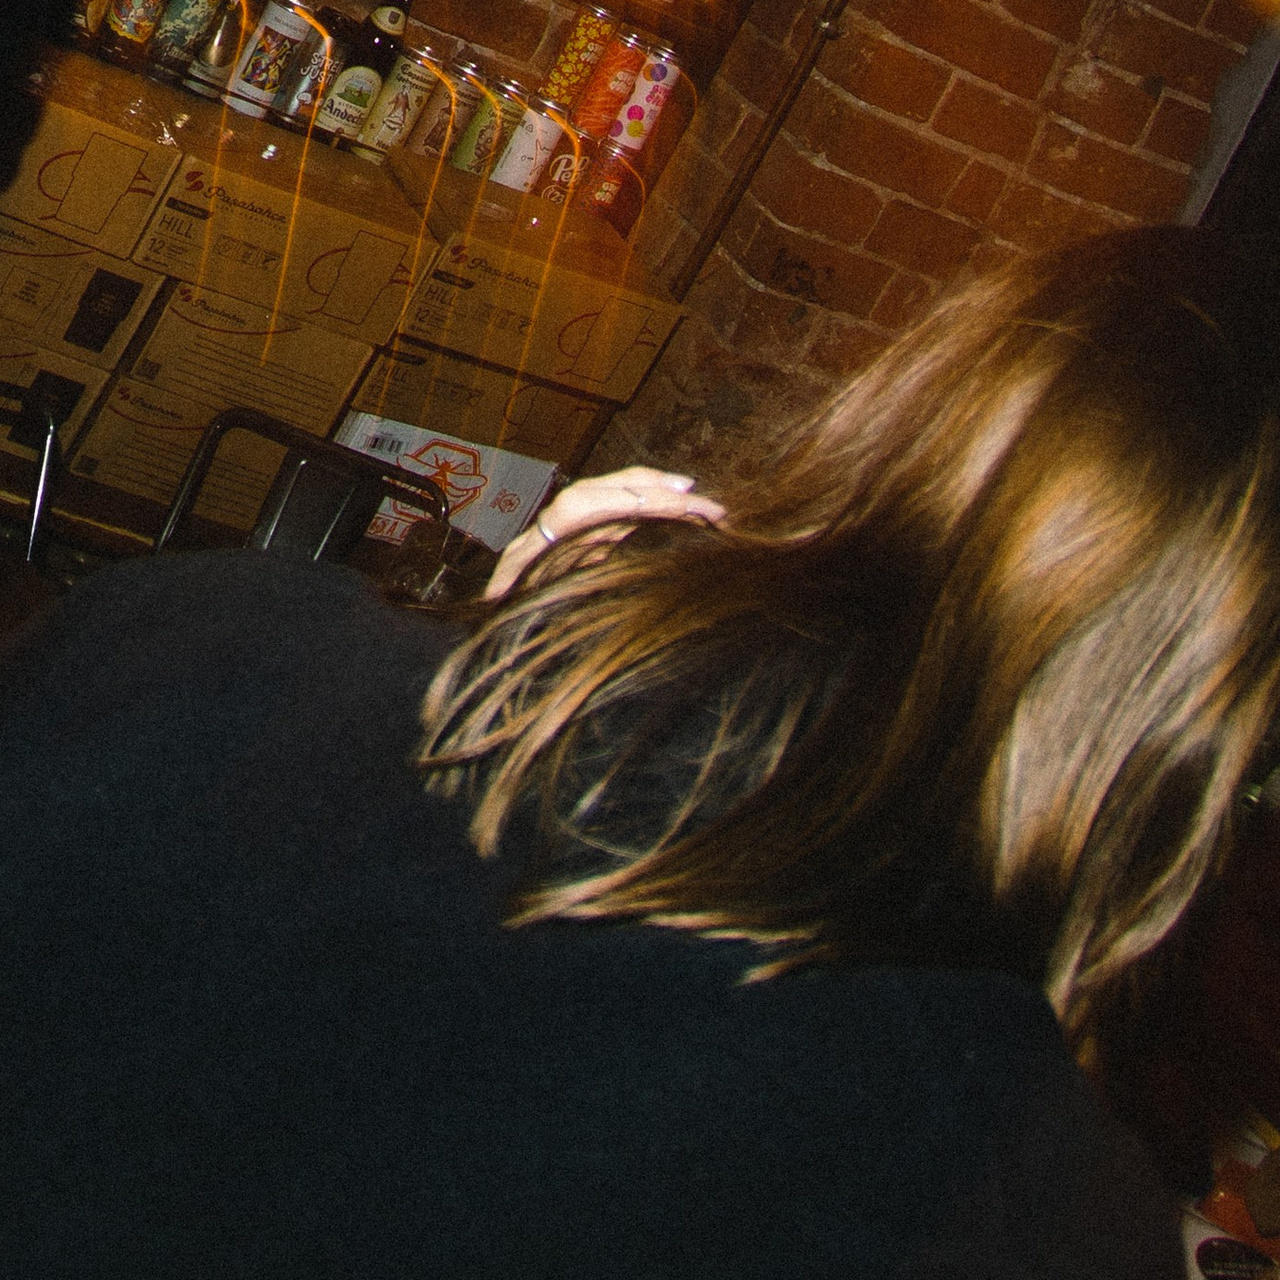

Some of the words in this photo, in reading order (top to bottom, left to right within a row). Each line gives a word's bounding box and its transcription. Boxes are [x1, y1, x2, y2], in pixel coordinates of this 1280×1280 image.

[157, 212, 196, 239] HILL
[146, 236, 166, 255] 12
[423, 283, 456, 307] HILL
[413, 306, 430, 323] 12
